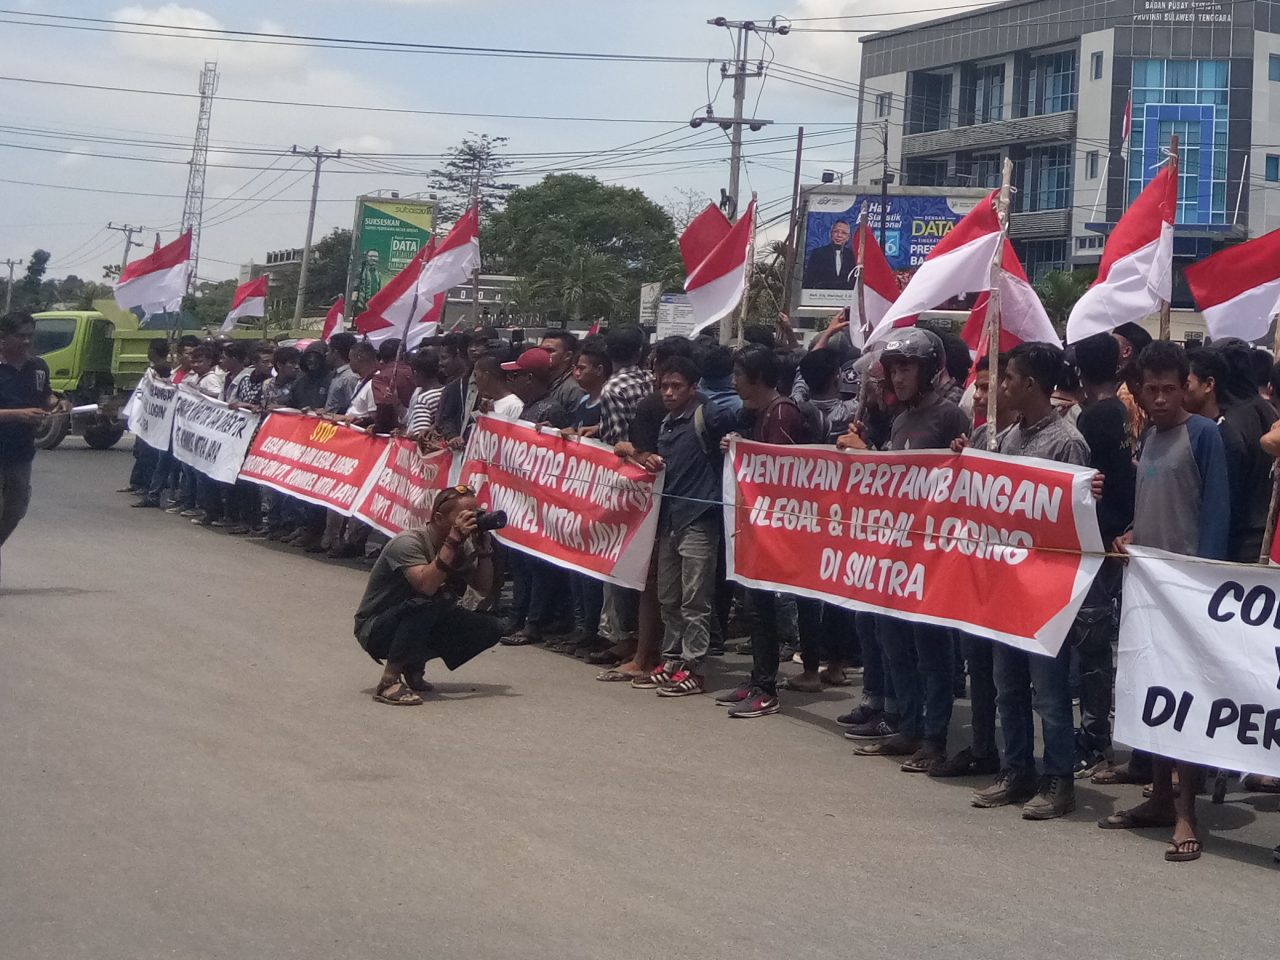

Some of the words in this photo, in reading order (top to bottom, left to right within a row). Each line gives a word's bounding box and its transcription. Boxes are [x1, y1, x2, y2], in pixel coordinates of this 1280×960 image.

[1145, 1, 1166, 9] BADAN
[1168, 1, 1188, 10] PUSAT
[1164, 12, 1195, 22] SULAWESI
[1198, 13, 1232, 22] TENGGARA
[365, 218, 400, 227] SUKSESKAN
[867, 220, 903, 229] Nasonal
[911, 220, 954, 237] DATA
[392, 240, 417, 252] DATA
[910, 244, 936, 255] PRES
[309, 421, 338, 444] STOP
[500, 435, 565, 489] KURATOR
[561, 455, 595, 499] DAN
[737, 453, 843, 493] HENTIKAN
[846, 461, 1063, 524] PERTAMBANGAN
[541, 501, 586, 553] MITRA
[588, 519, 629, 563] JAYA
[750, 495, 822, 533] ILEGAL
[828, 504, 843, 537] &
[850, 506, 914, 548] ILEGAL
[922, 514, 1034, 565] LOGING
[819, 547, 840, 583] DI
[843, 549, 926, 601] SULTRA
[1141, 685, 1194, 733] DI
